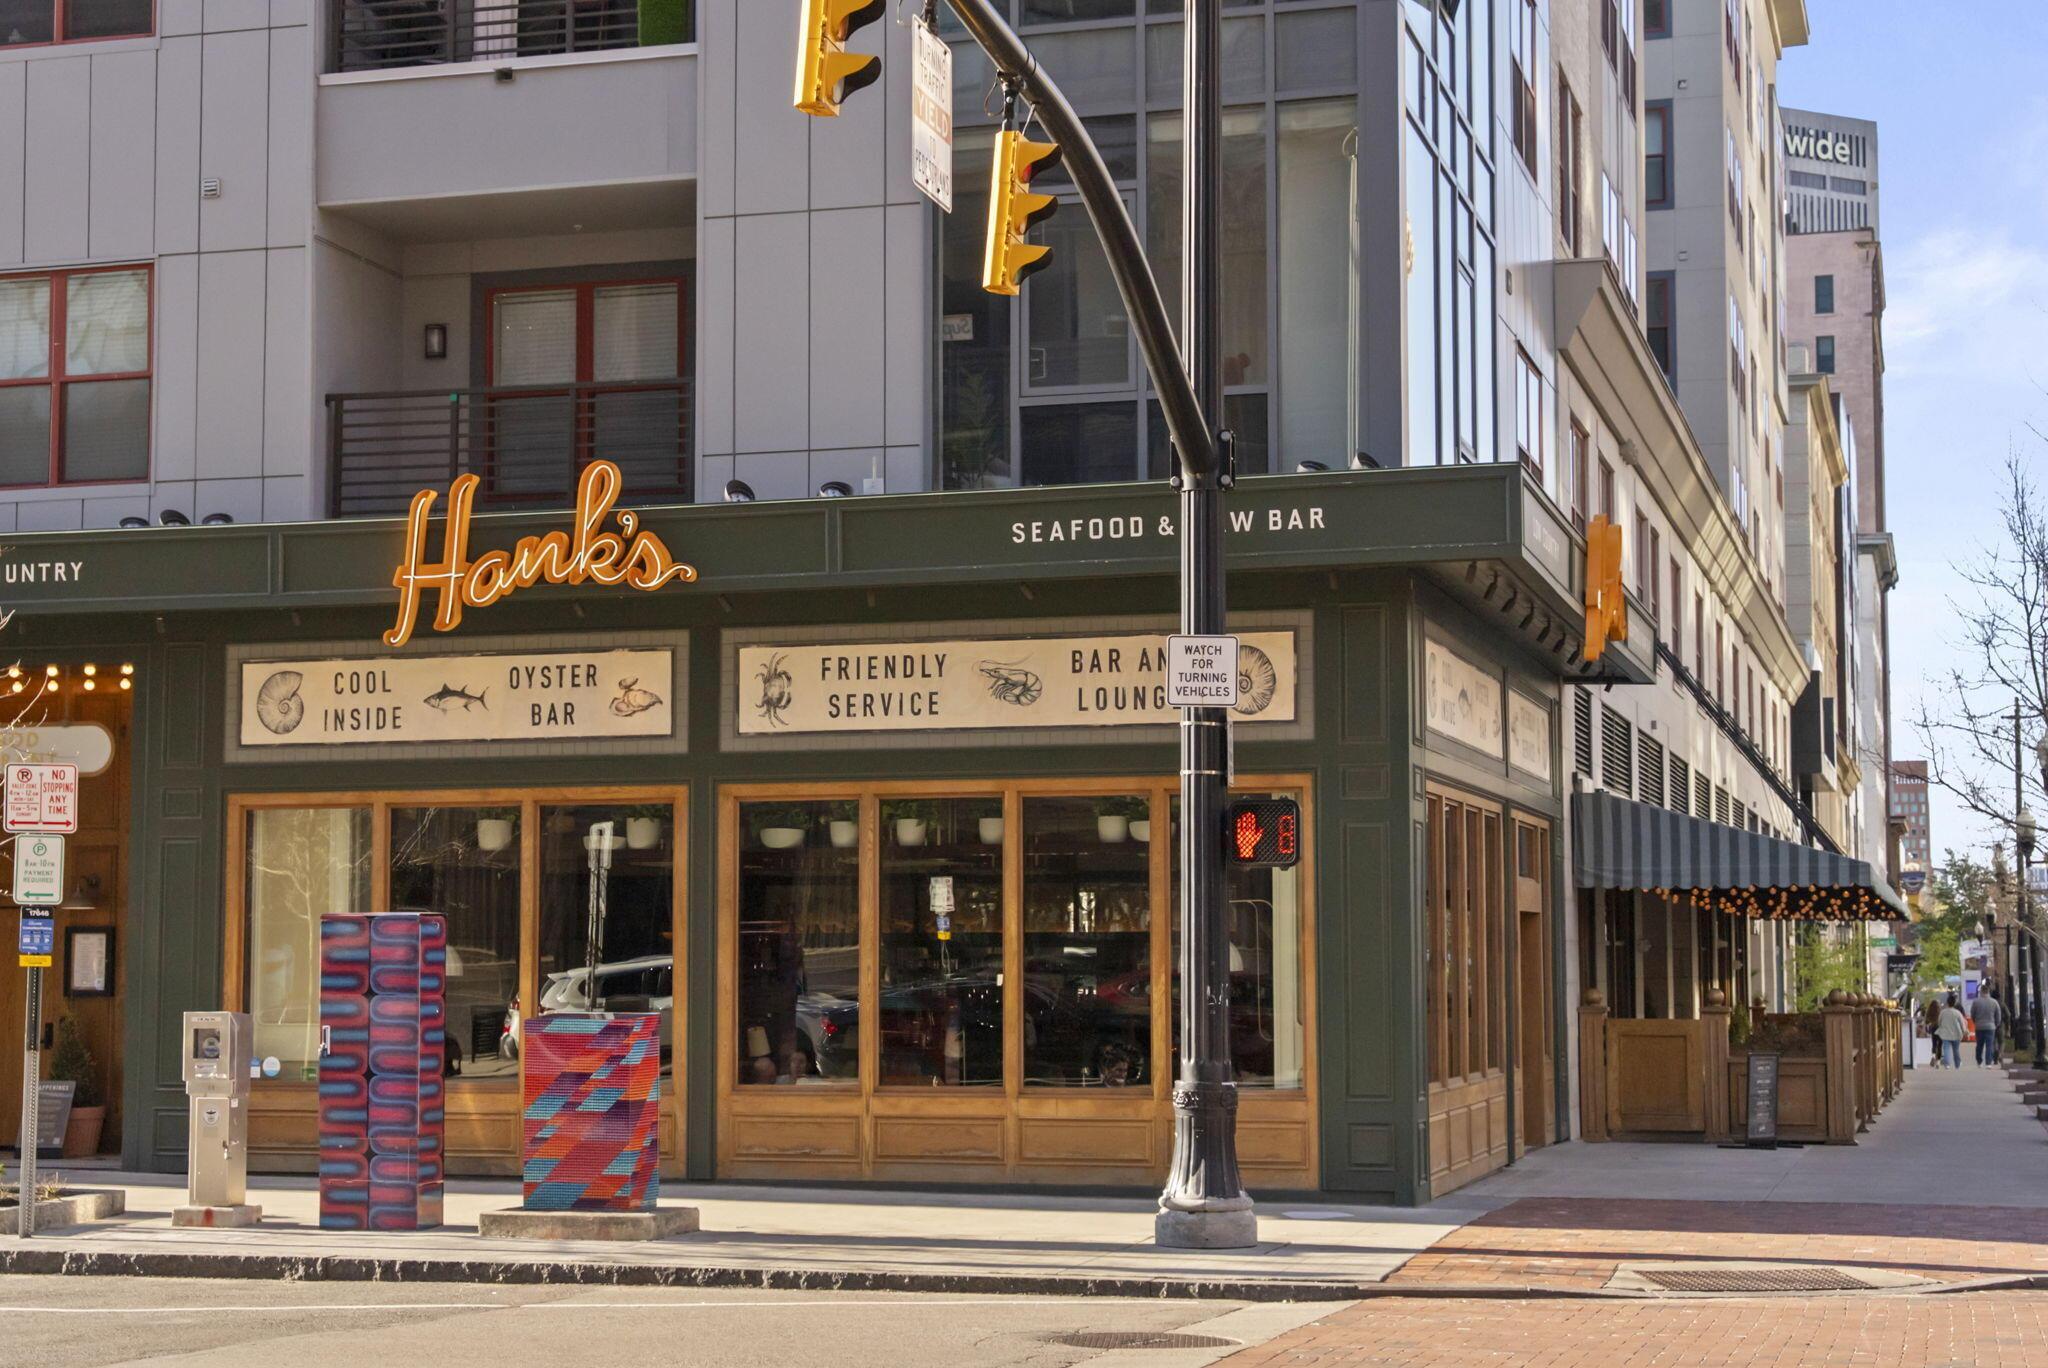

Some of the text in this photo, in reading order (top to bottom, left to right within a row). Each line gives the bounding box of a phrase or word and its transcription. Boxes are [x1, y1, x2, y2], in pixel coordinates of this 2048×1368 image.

[916, 88, 948, 137] YIELD
[1785, 129, 1851, 162] wide
[1011, 516, 1144, 544] SEAFOOD
[1158, 516, 1175, 536] &
[1268, 507, 1326, 531] BAR
[383, 459, 698, 648] Hank's
[1071, 647, 1167, 674] BAR AN
[1184, 644, 1222, 656] WATCH
[821, 653, 947, 680] FRIENDLY
[1191, 658, 1214, 669] FOR
[334, 670, 392, 695] COOL
[509, 664, 597, 690] OYSTER
[1178, 672, 1227, 683] TURNING
[1078, 685, 1181, 711] LOUNG
[1175, 686, 1230, 697] VEHICLES
[531, 702, 575, 726] BAR
[828, 691, 939, 719] SERVICE
[323, 706, 402, 732] INSIDE
[52, 769, 65, 780] NO
[43, 783, 73, 793] STOPPING
[49, 795, 66, 804] ANY
[48, 806, 67, 815] TIME
